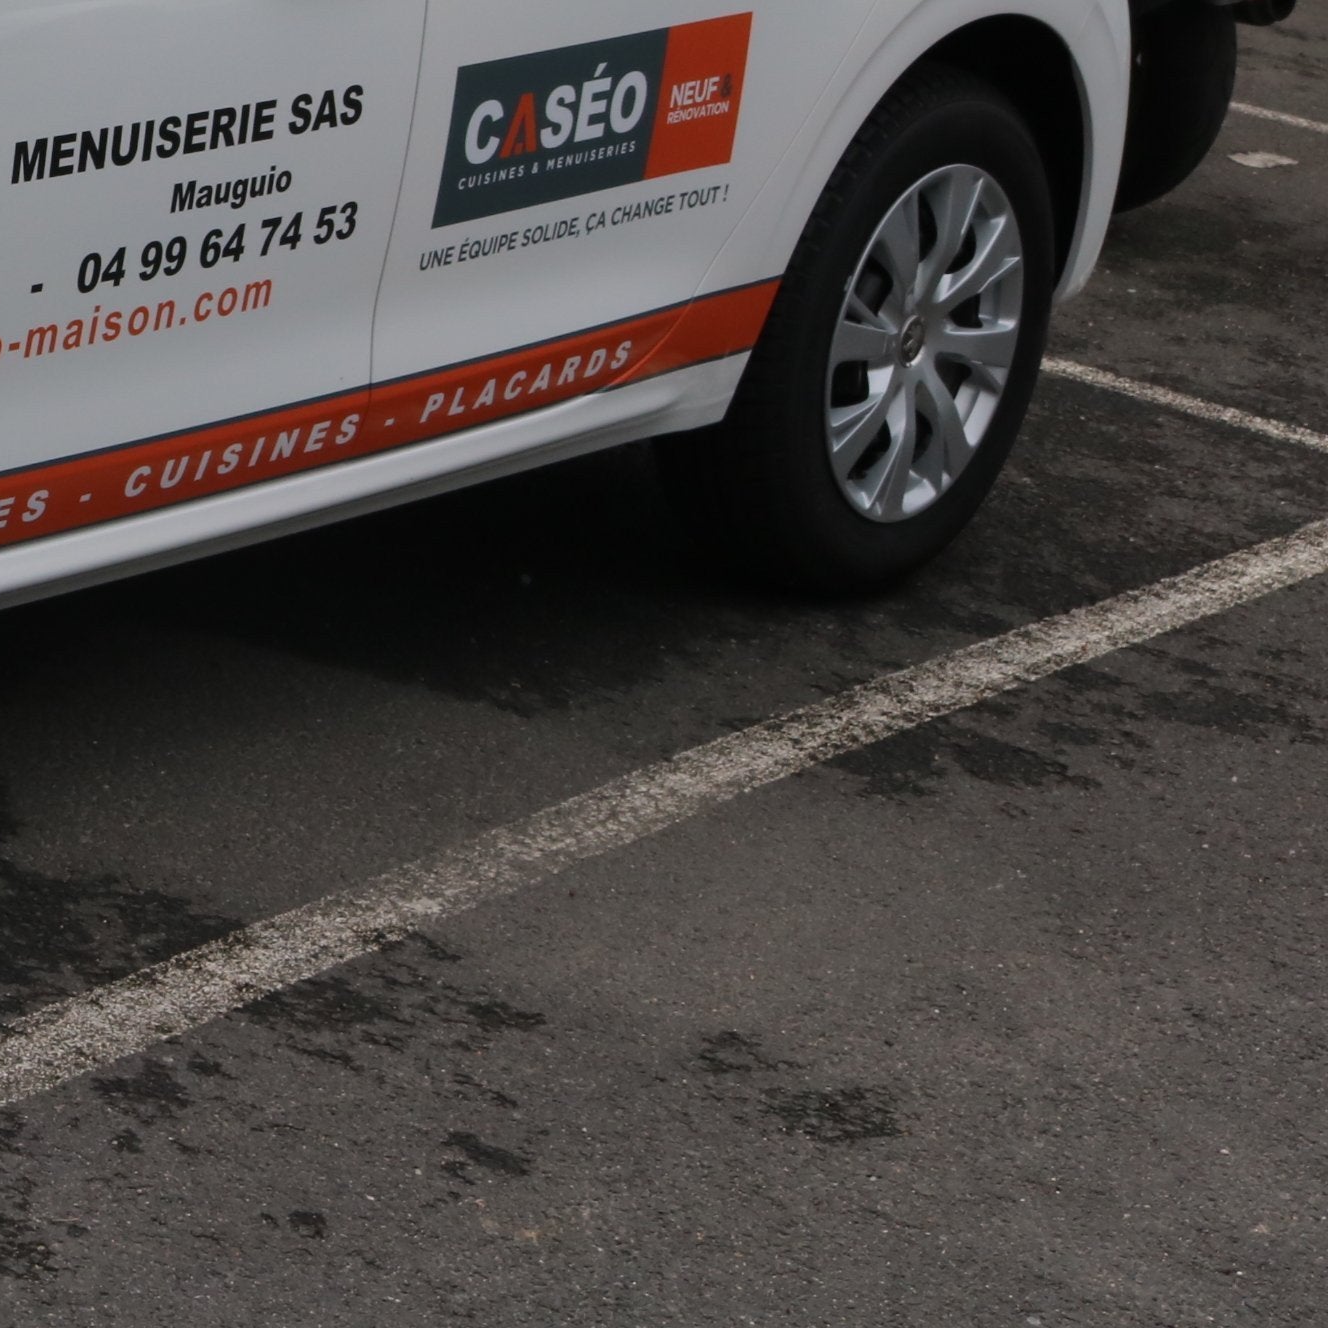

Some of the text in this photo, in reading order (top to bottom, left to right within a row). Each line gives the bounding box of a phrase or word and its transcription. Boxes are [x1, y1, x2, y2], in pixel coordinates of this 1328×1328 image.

[11, 99, 277, 184] MENUISERIE
[288, 84, 364, 135] SAS
[464, 61, 648, 165] CASÉO
[670, 76, 720, 108] NEUF
[170, 165, 293, 213] Mauguio
[458, 140, 637, 190] CUISINES & MENUISERIES
[77, 246, 127, 294] 04
[138, 235, 187, 282] 99
[199, 223, 246, 269] 64
[259, 211, 304, 257] 74
[313, 201, 359, 245] 53
[419, 245, 455, 271] UNE
[457, 231, 519, 263] ÉQUIPE
[521, 217, 580, 247] SOLIDE,
[585, 213, 607, 235] ÇA
[610, 194, 675, 224] CHANGE
[679, 185, 721, 211] TOUT
[123, 413, 360, 498] CUISINES
[419, 340, 633, 423] PLACARDS
